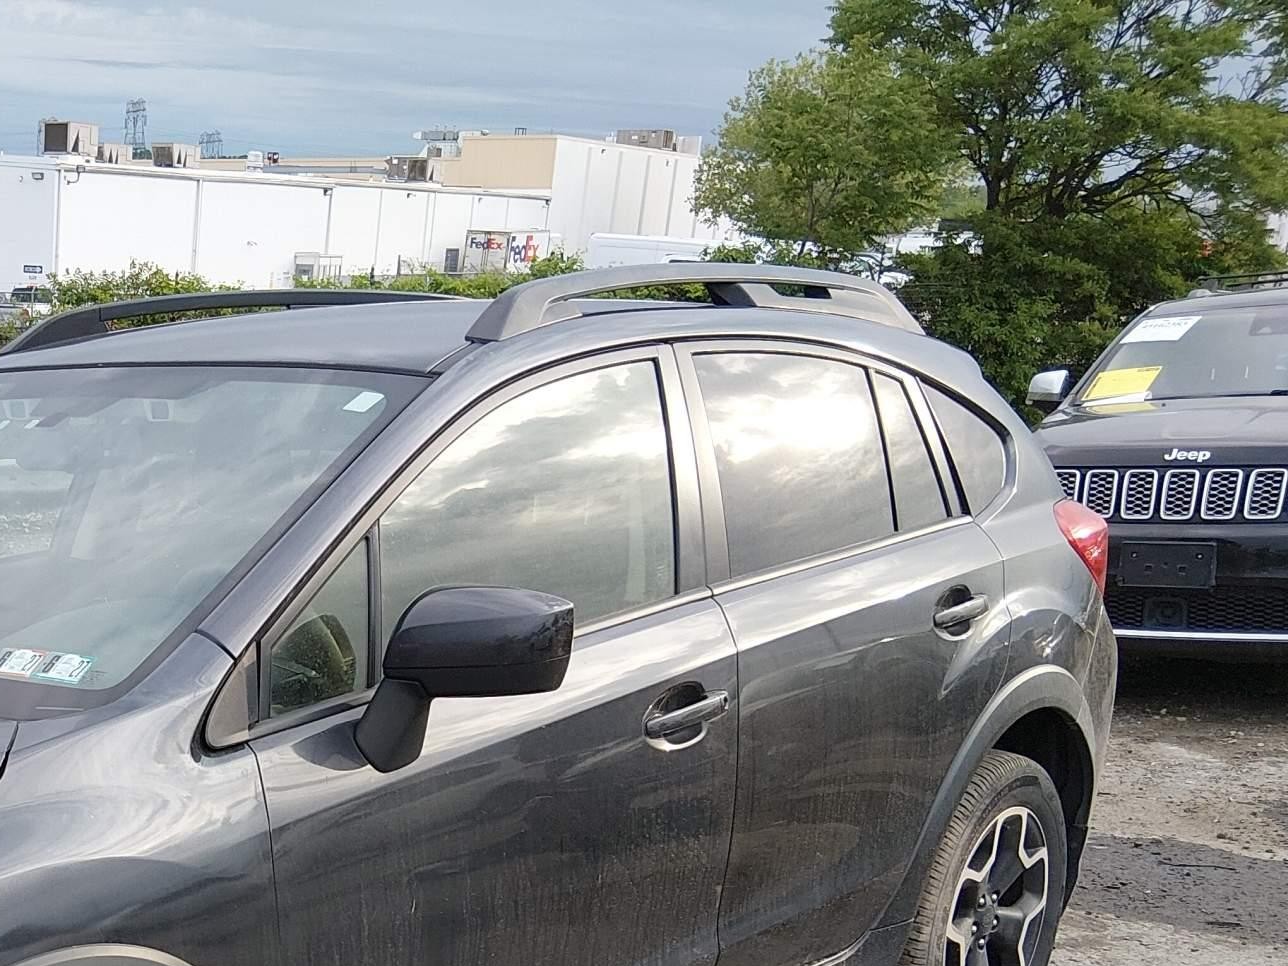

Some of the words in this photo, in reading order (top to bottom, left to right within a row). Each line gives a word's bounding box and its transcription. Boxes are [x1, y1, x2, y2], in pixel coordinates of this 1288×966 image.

[470, 237, 504, 250] FedEx
[509, 235, 539, 264] FedEx
[1164, 448, 1211, 463] Jeep
